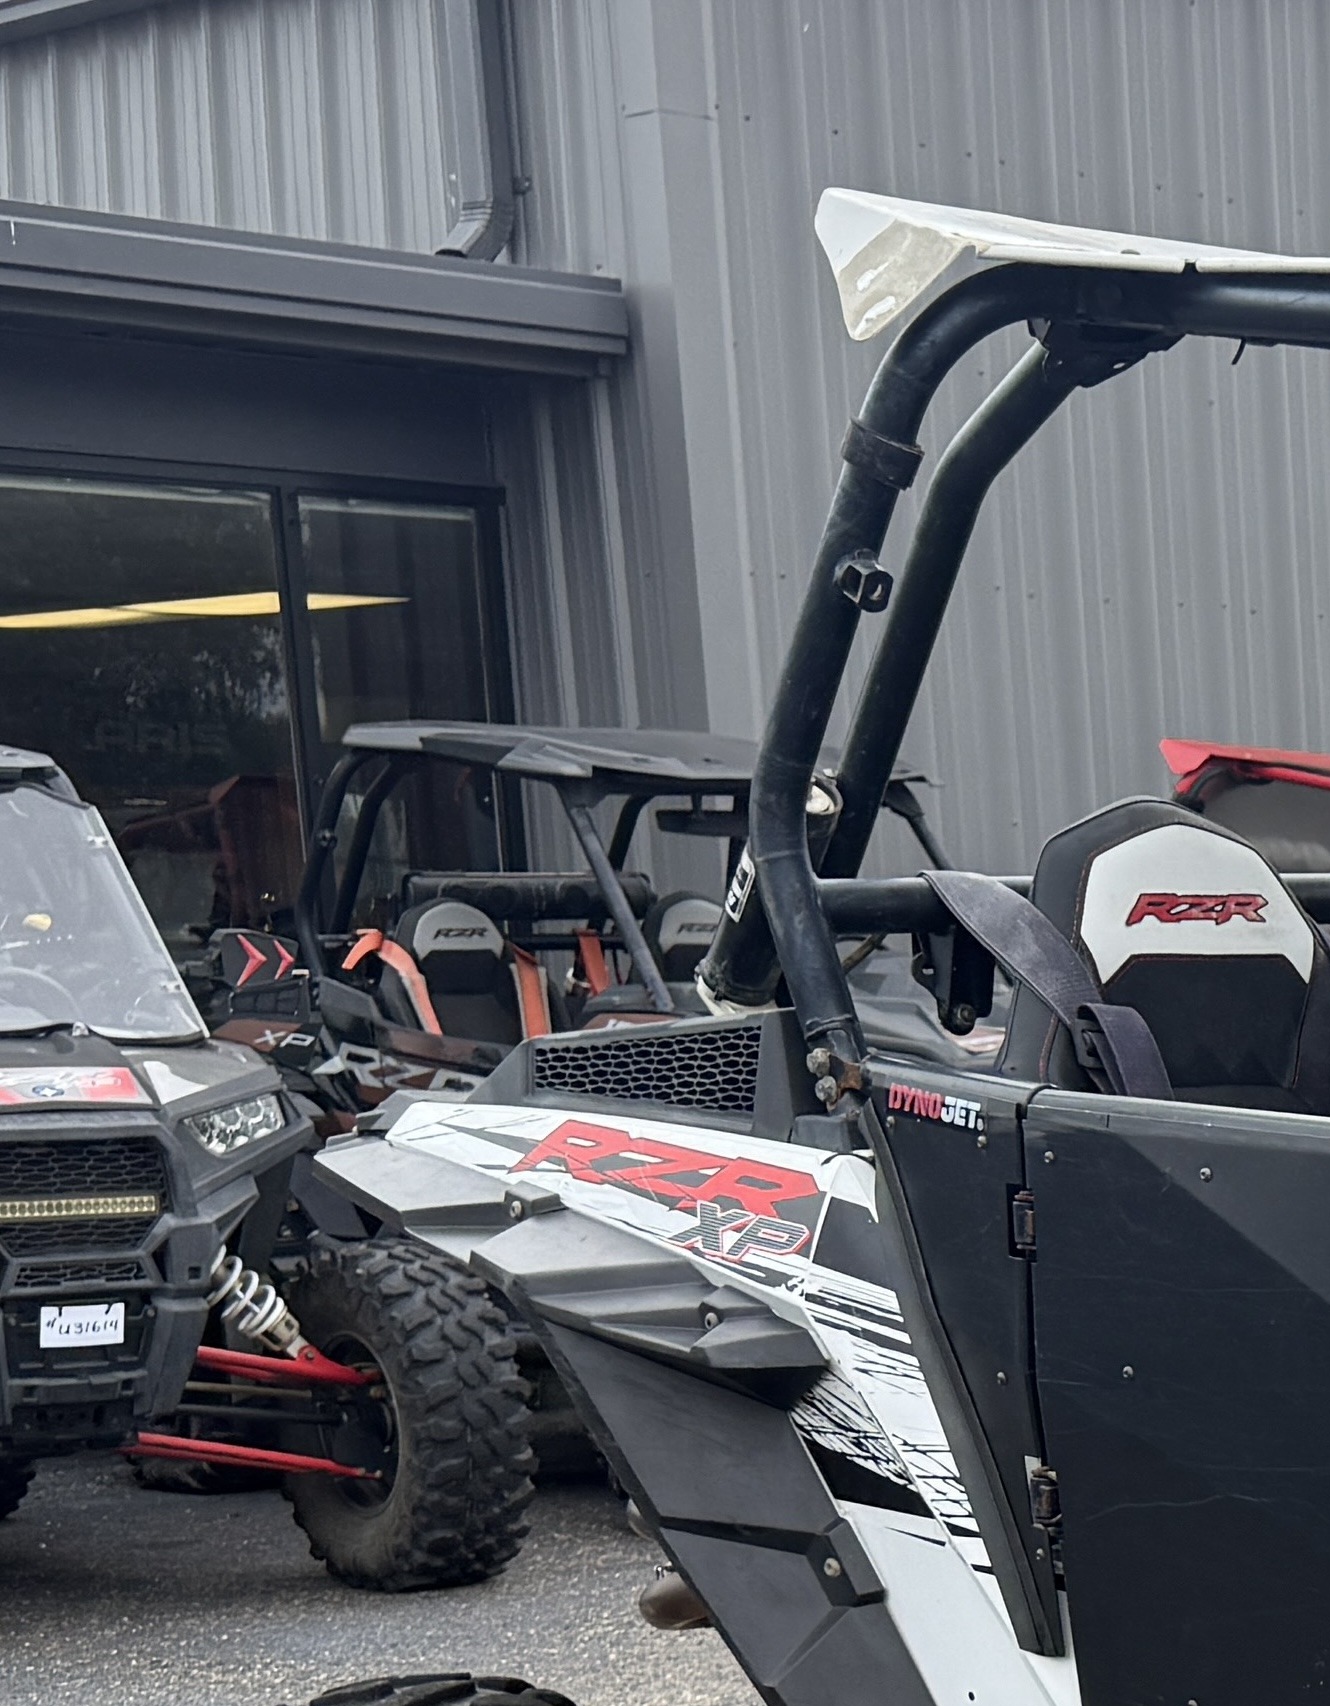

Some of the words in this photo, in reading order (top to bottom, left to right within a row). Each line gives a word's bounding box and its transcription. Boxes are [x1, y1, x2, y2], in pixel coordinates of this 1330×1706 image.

[1126, 892, 1269, 926] RZR
[433, 927, 487, 940] RZR
[678, 923, 719, 935] RZ
[254, 1029, 316, 1048] XP
[888, 1082, 982, 1130] DYNOJET
[507, 1118, 820, 1218] RZR
[668, 1200, 812, 1263] XP
